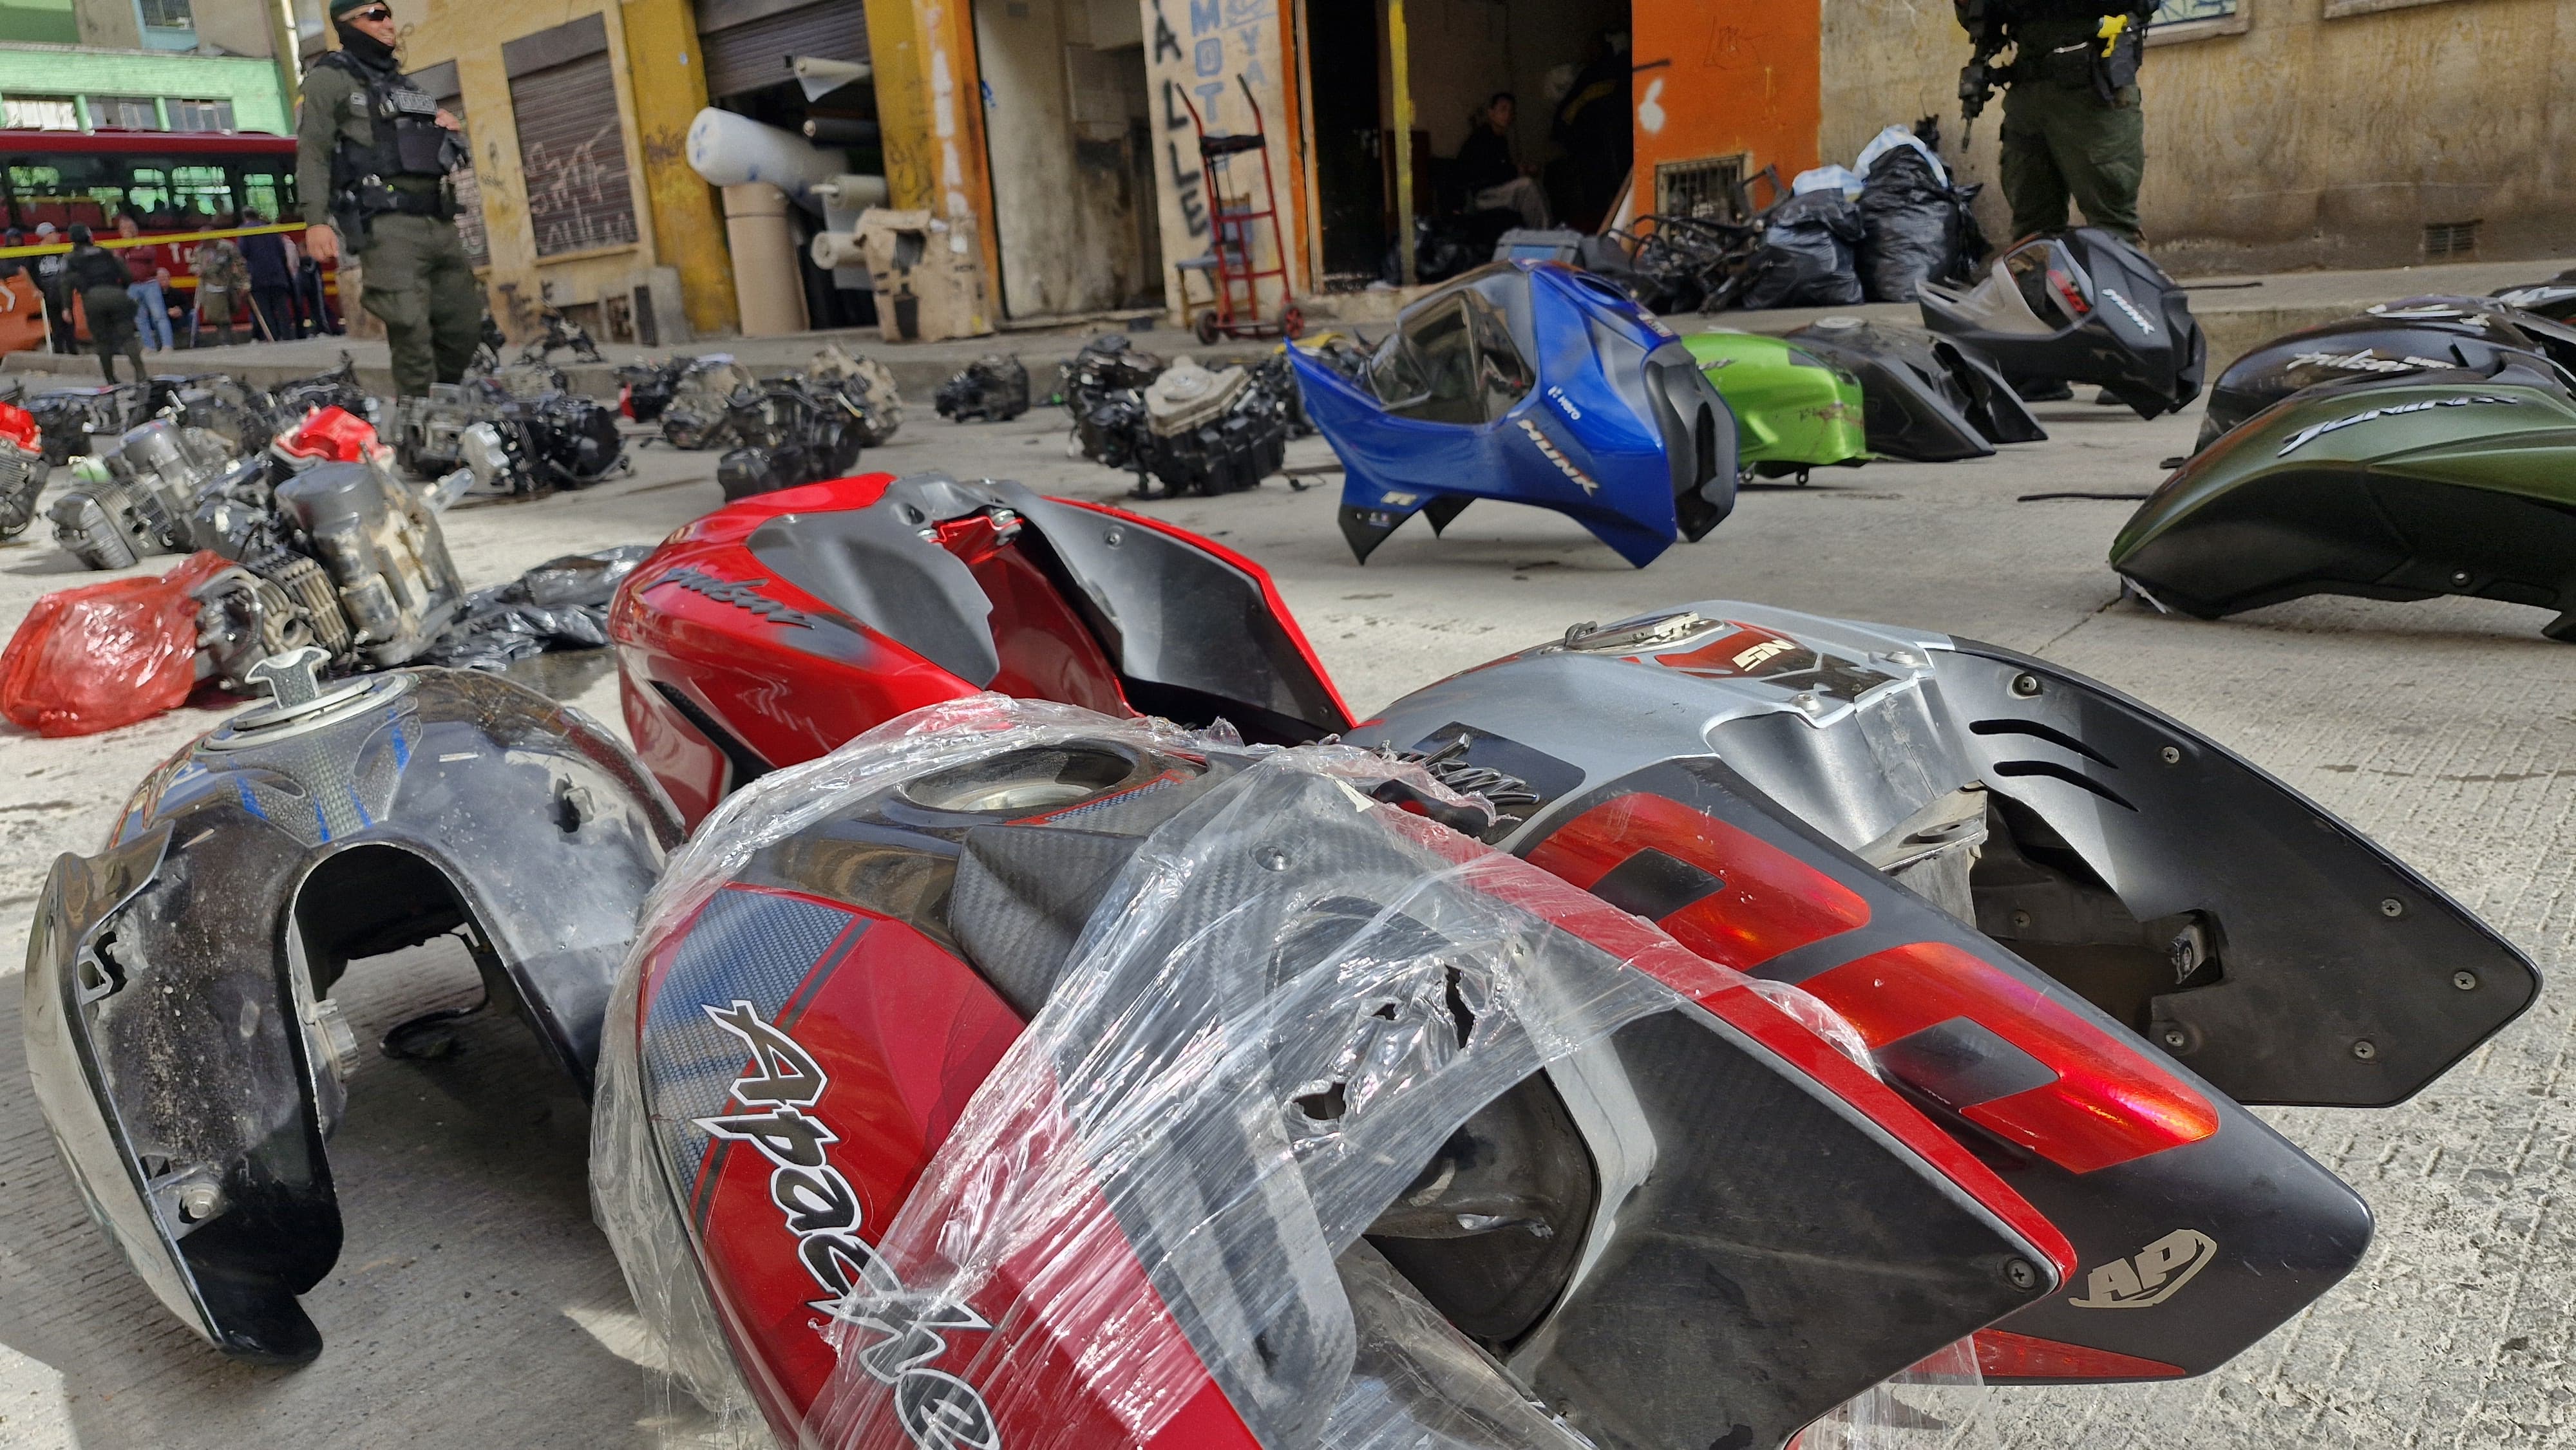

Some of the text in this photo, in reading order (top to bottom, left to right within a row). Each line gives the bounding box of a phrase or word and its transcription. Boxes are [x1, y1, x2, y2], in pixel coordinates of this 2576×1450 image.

[1153, 0, 1208, 238] ALLE
[1517, 419, 1600, 497] HUNK
[691, 999, 1001, 1450] Apache
